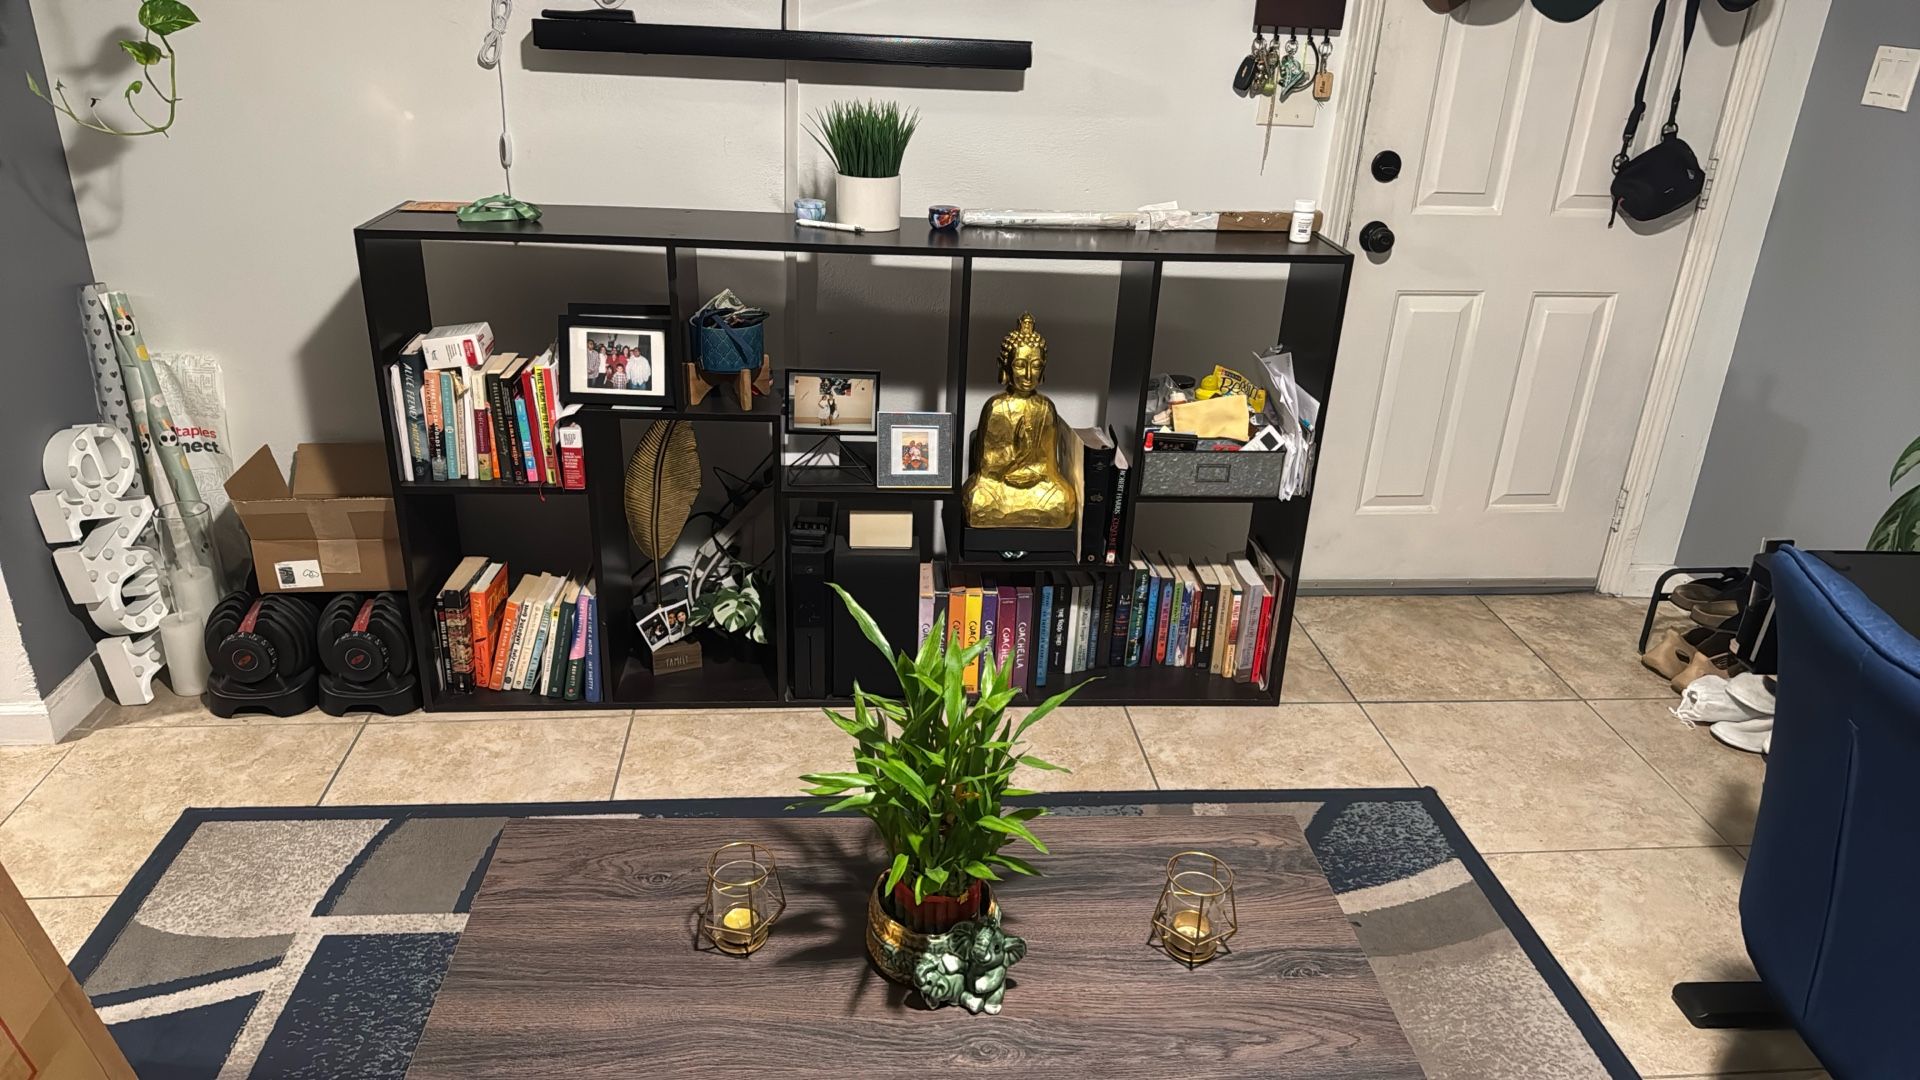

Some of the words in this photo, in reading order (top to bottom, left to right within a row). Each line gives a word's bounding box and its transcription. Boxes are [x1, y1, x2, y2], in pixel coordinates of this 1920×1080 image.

[403, 362, 415, 388] ALICE
[536, 371, 544, 385] WILL
[429, 378, 437, 399] WHERE
[538, 385, 546, 403] TEACH
[406, 389, 418, 420] FEENEY
[173, 426, 217, 439] taples
[432, 415, 442, 447] CRAWDADS
[543, 421, 549, 429] BE
[180, 441, 220, 454] nect
[1117, 470, 1126, 493] ROBERT
[1114, 493, 1123, 515] HARRIS
[1056, 607, 1065, 618] THE
[1016, 622, 1027, 669] COACHELLA
